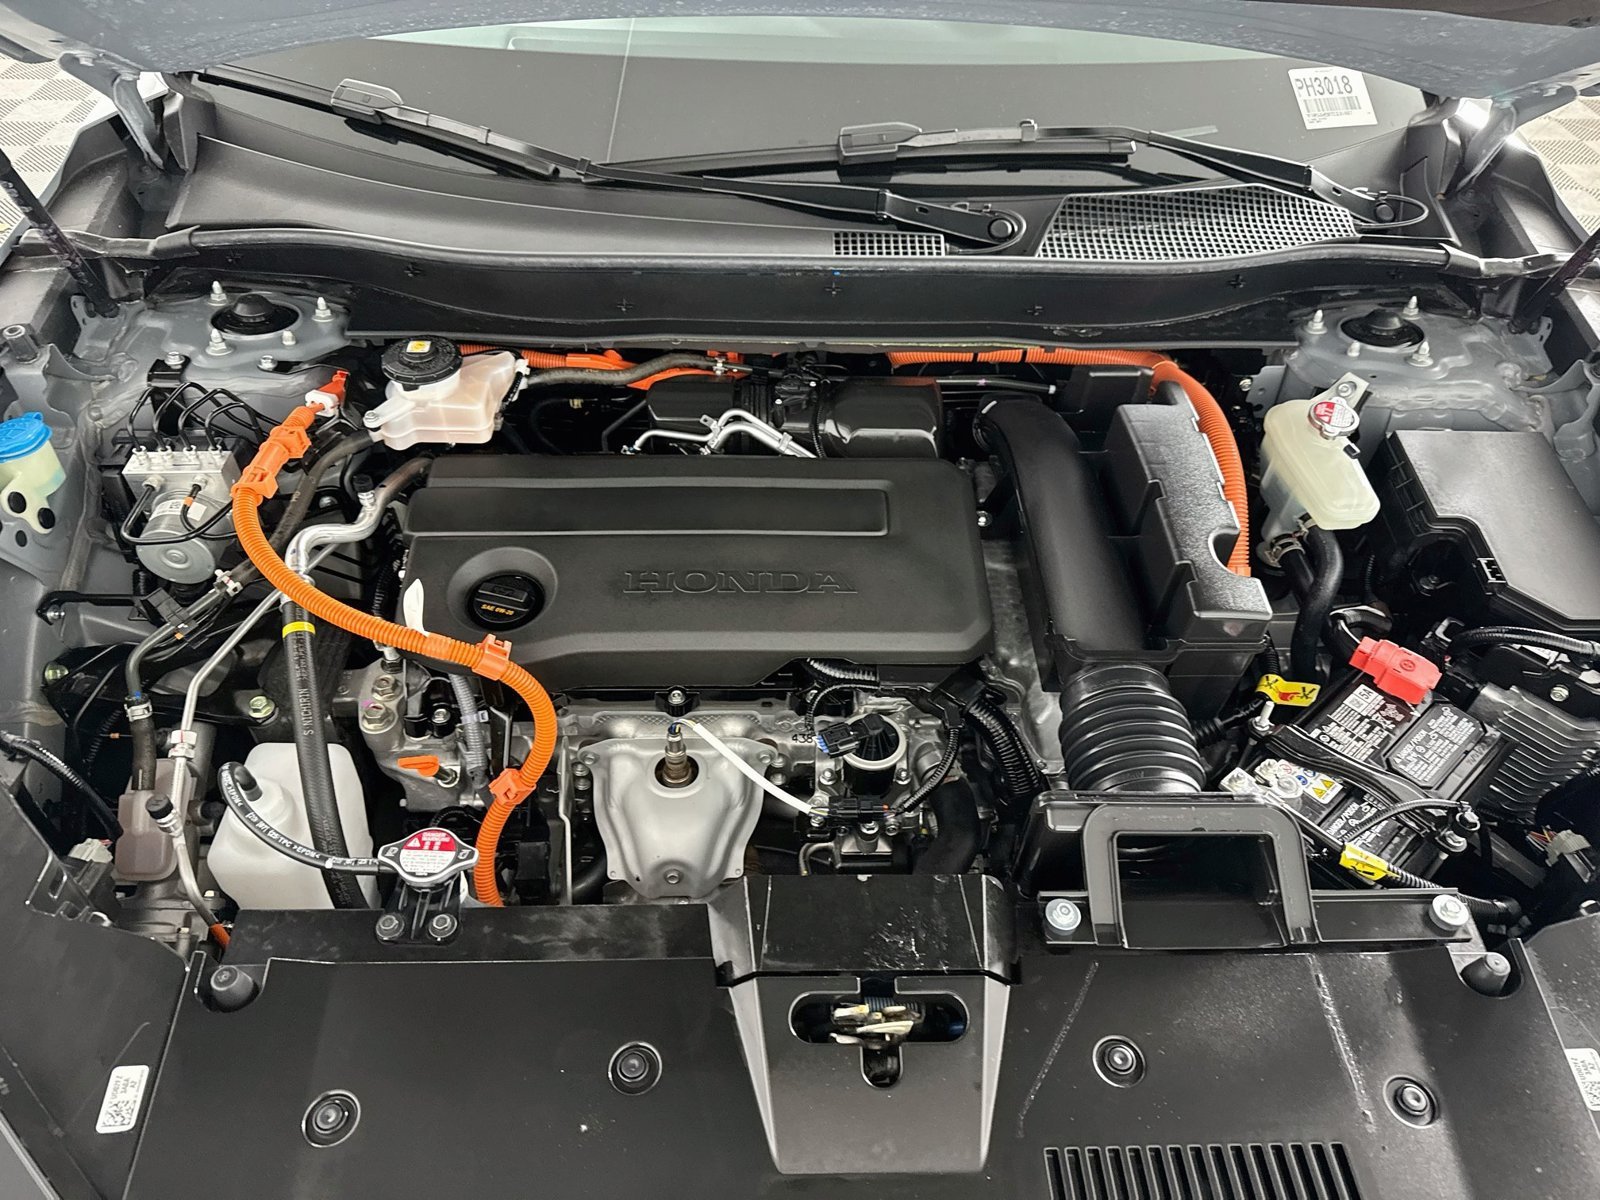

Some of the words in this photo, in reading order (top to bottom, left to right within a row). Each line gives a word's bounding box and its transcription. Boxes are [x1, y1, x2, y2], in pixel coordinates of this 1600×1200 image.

[1294, 75, 1353, 97] PH3018
[623, 571, 858, 594] HONDA
[481, 604, 495, 612] SAE
